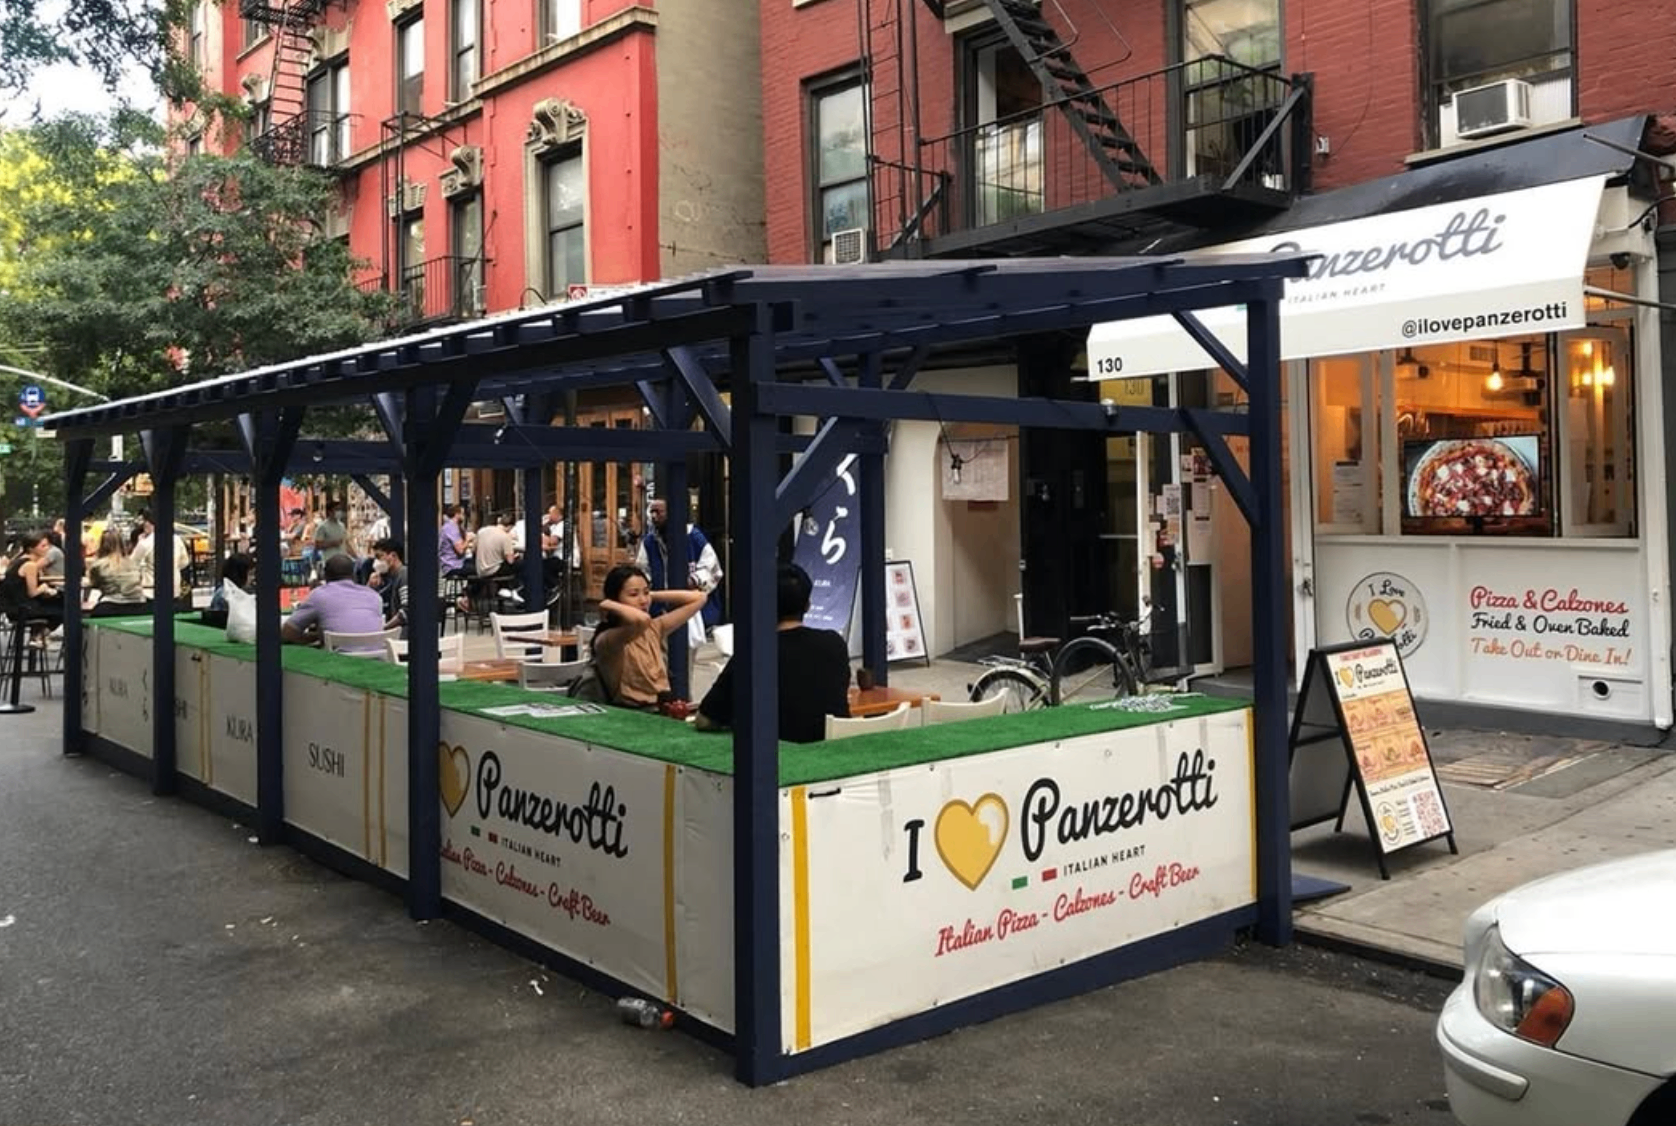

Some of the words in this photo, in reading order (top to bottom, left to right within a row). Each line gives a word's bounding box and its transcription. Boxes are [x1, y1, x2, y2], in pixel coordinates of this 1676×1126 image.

[1270, 207, 1507, 283] anzerotti
[1343, 283, 1386, 297] HEART
[1402, 301, 1568, 337] @ilovepanzerotti
[1097, 356, 1123, 374] 130
[1470, 585, 1519, 610] Pizza
[1523, 589, 1538, 611] &
[1540, 588, 1629, 615] Calzones
[1470, 612, 1512, 630] Fried
[1514, 614, 1527, 631] &
[1533, 614, 1575, 634] Oven
[1575, 617, 1630, 638] Baked
[1471, 637, 1508, 655] Take
[1510, 639, 1543, 658] Out
[1544, 648, 1564, 659] or
[1564, 644, 1602, 663] Dine
[1603, 647, 1632, 666] In!
[309, 742, 345, 778] SUSHI
[476, 750, 629, 859] Panzerotti
[903, 818, 925, 883] I
[1020, 748, 1219, 863] Panzerotti
[501, 836, 533, 858] ITALIAN
[534, 848, 562, 869] HEART
[1063, 855, 1108, 877] ITALIAN
[1112, 844, 1146, 864] HEART
[463, 846, 488, 877] Pizza
[495, 861, 539, 898] Calzones
[548, 881, 580, 921] Craft
[581, 894, 612, 927] Beer
[934, 917, 995, 958] Italian
[997, 908, 1040, 941] Pizza
[1053, 886, 1117, 923] Calzones
[1129, 871, 1168, 900] Craft
[1168, 862, 1200, 888] Beer
